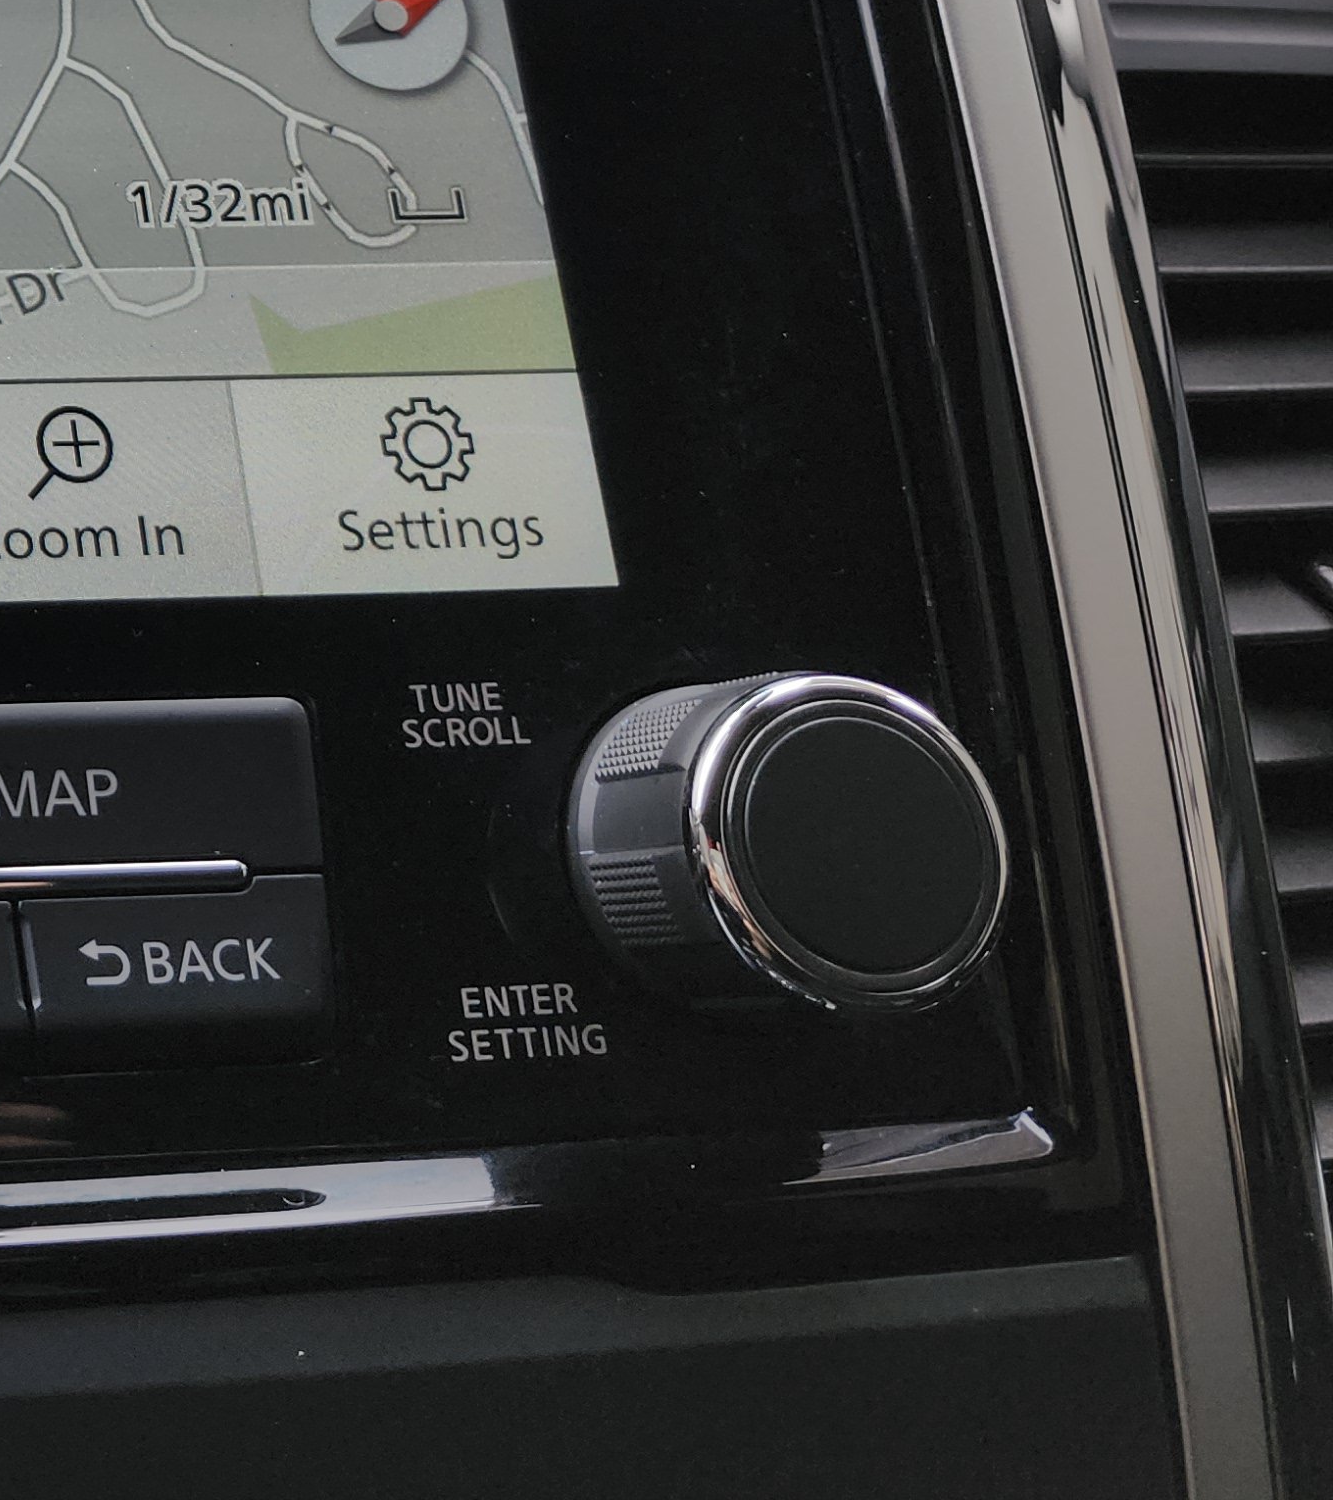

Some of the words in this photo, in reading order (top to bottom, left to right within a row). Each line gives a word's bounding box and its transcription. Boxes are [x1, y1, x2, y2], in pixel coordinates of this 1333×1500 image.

[130, 178, 311, 229] 1/32mi
[6, 267, 67, 314] Dr
[139, 514, 186, 558] In
[337, 507, 546, 560] Settings
[409, 682, 502, 713] TUNE
[402, 715, 531, 749] SCROLL
[142, 936, 281, 986] BACK
[461, 983, 578, 1020] ENTER
[447, 1023, 607, 1063] SETTING
